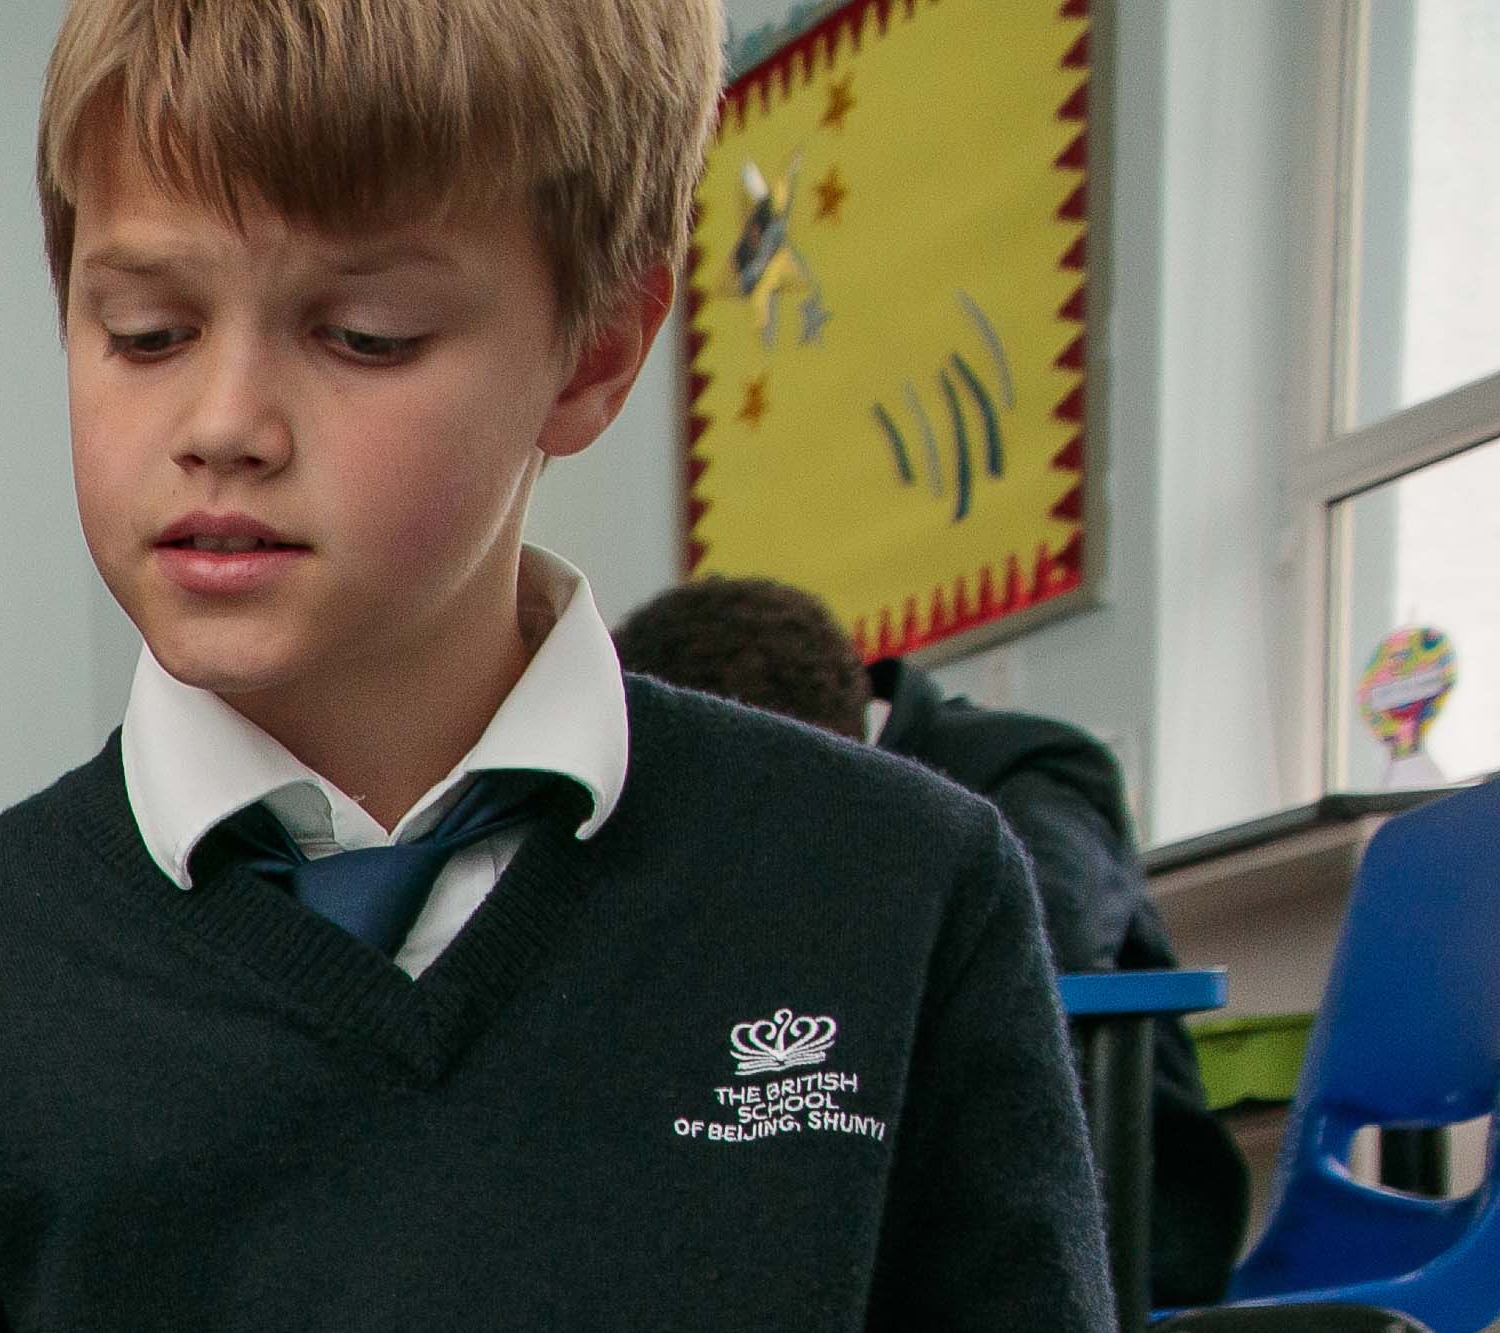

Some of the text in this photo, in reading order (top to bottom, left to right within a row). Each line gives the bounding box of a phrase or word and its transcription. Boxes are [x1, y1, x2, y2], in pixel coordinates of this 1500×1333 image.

[713, 1071, 858, 1106] THE BRITISH
[737, 1092, 839, 1123] SCHOOL
[674, 1118, 704, 1137] OF
[808, 1110, 886, 1141] SHUNYI
